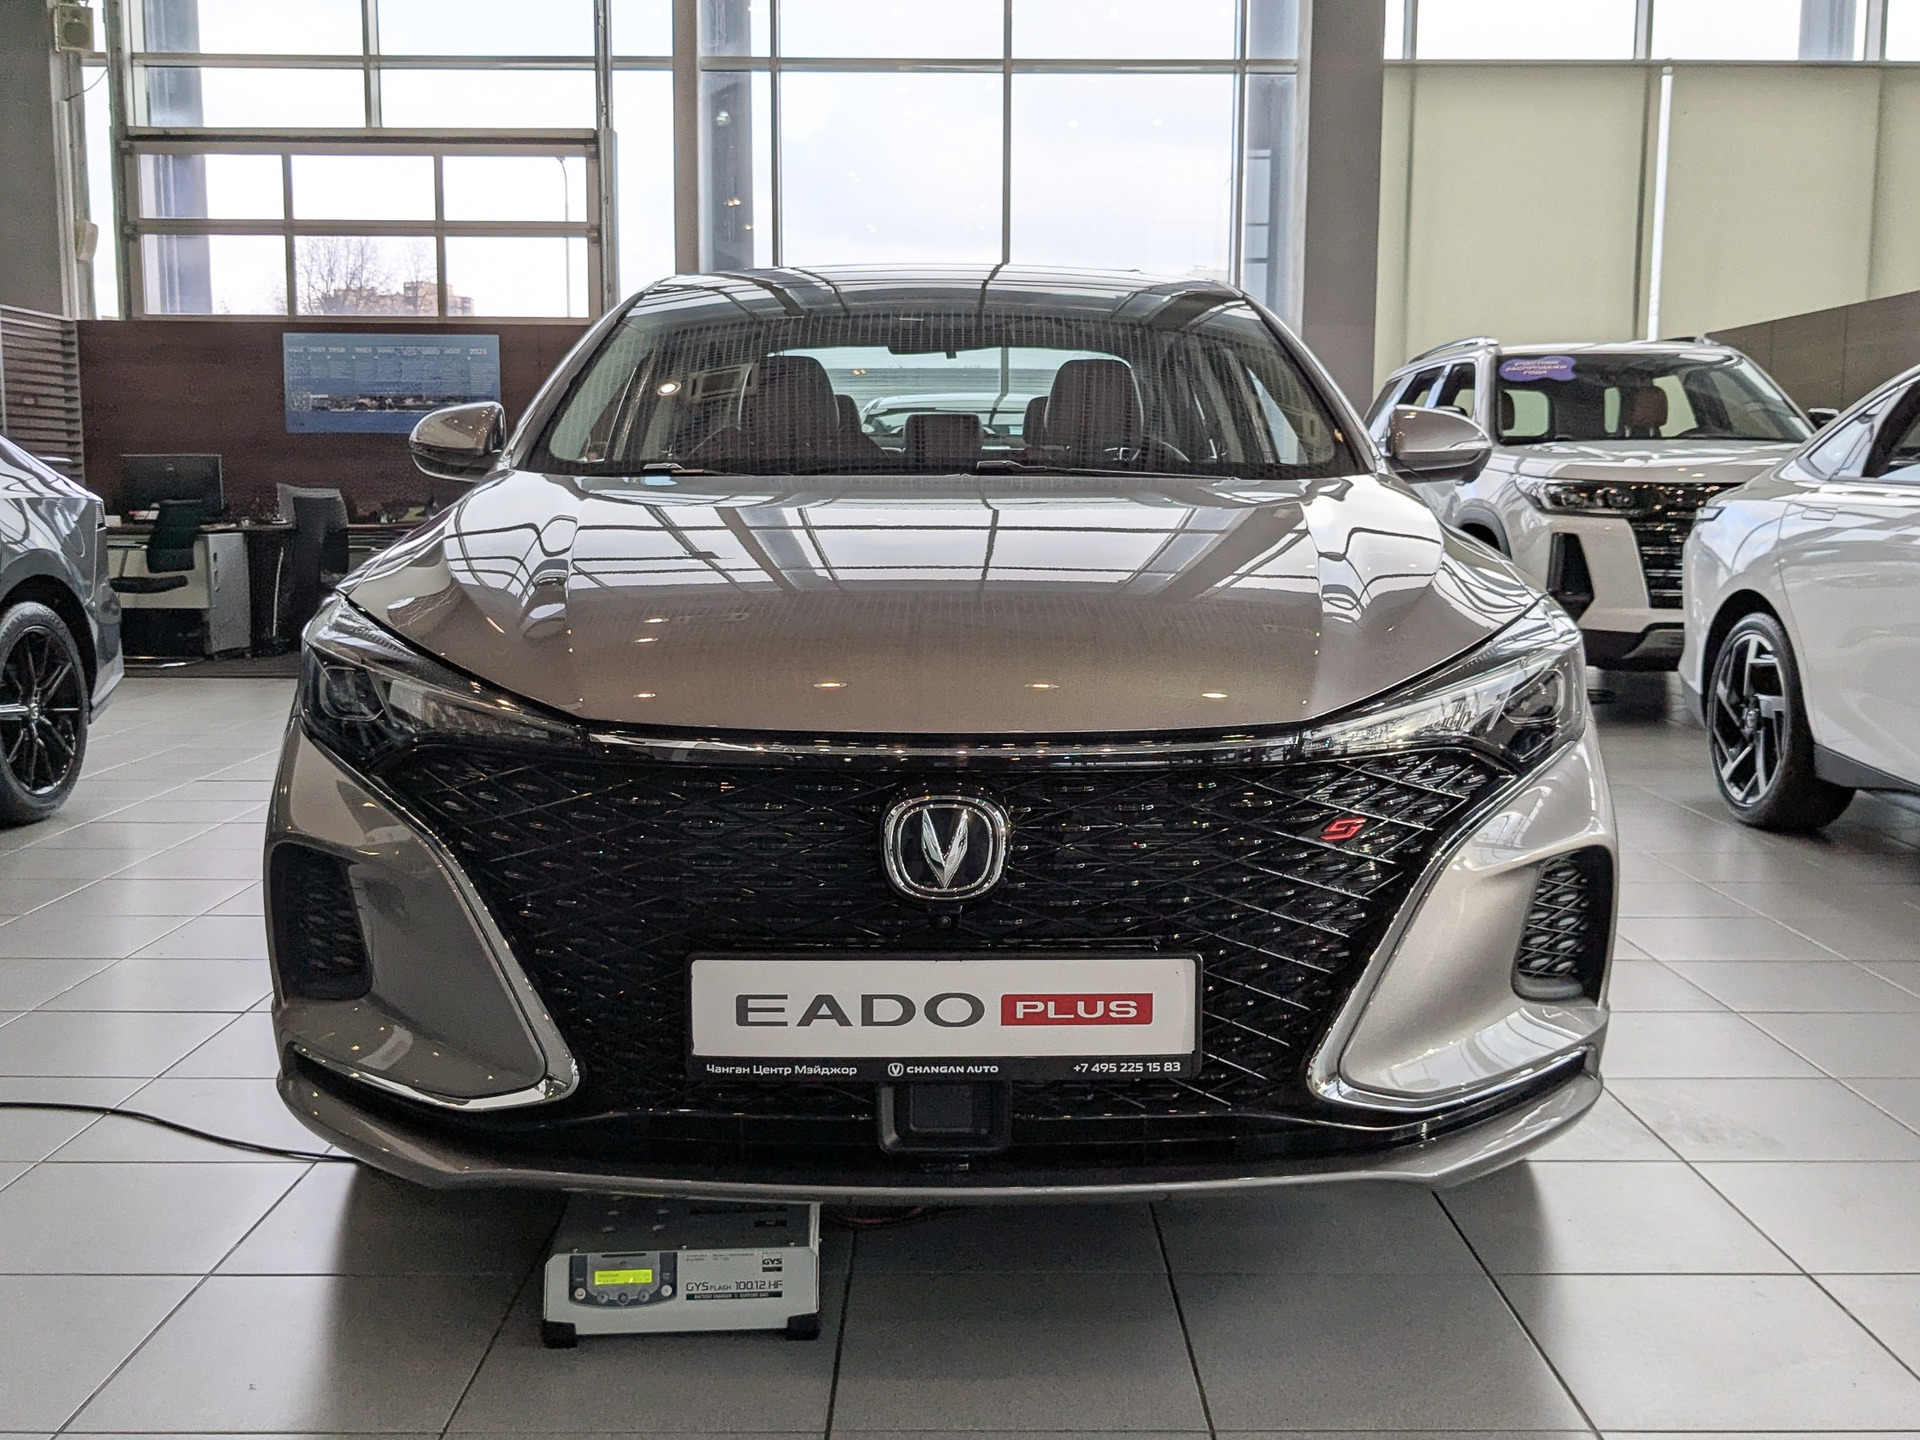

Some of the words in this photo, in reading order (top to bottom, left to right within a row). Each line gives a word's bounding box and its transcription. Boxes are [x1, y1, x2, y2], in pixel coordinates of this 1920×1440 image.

[735, 992, 986, 1028] EADO
[1016, 1000, 1138, 1020] PLUS
[706, 1064, 750, 1074] Чанган
[753, 1065, 792, 1076] Центр
[794, 1065, 858, 1076] Мэйджор
[906, 1065, 964, 1074] CHANGAN
[966, 1064, 999, 1074] AUTO
[1073, 1063, 1089, 1073] +7
[1091, 1063, 1117, 1073] 495
[1119, 1062, 1144, 1072] 225
[1146, 1062, 1161, 1072] 15
[1163, 1062, 1181, 1072] 83
[762, 1257, 782, 1265] GYS
[768, 1280, 783, 1289] HF
